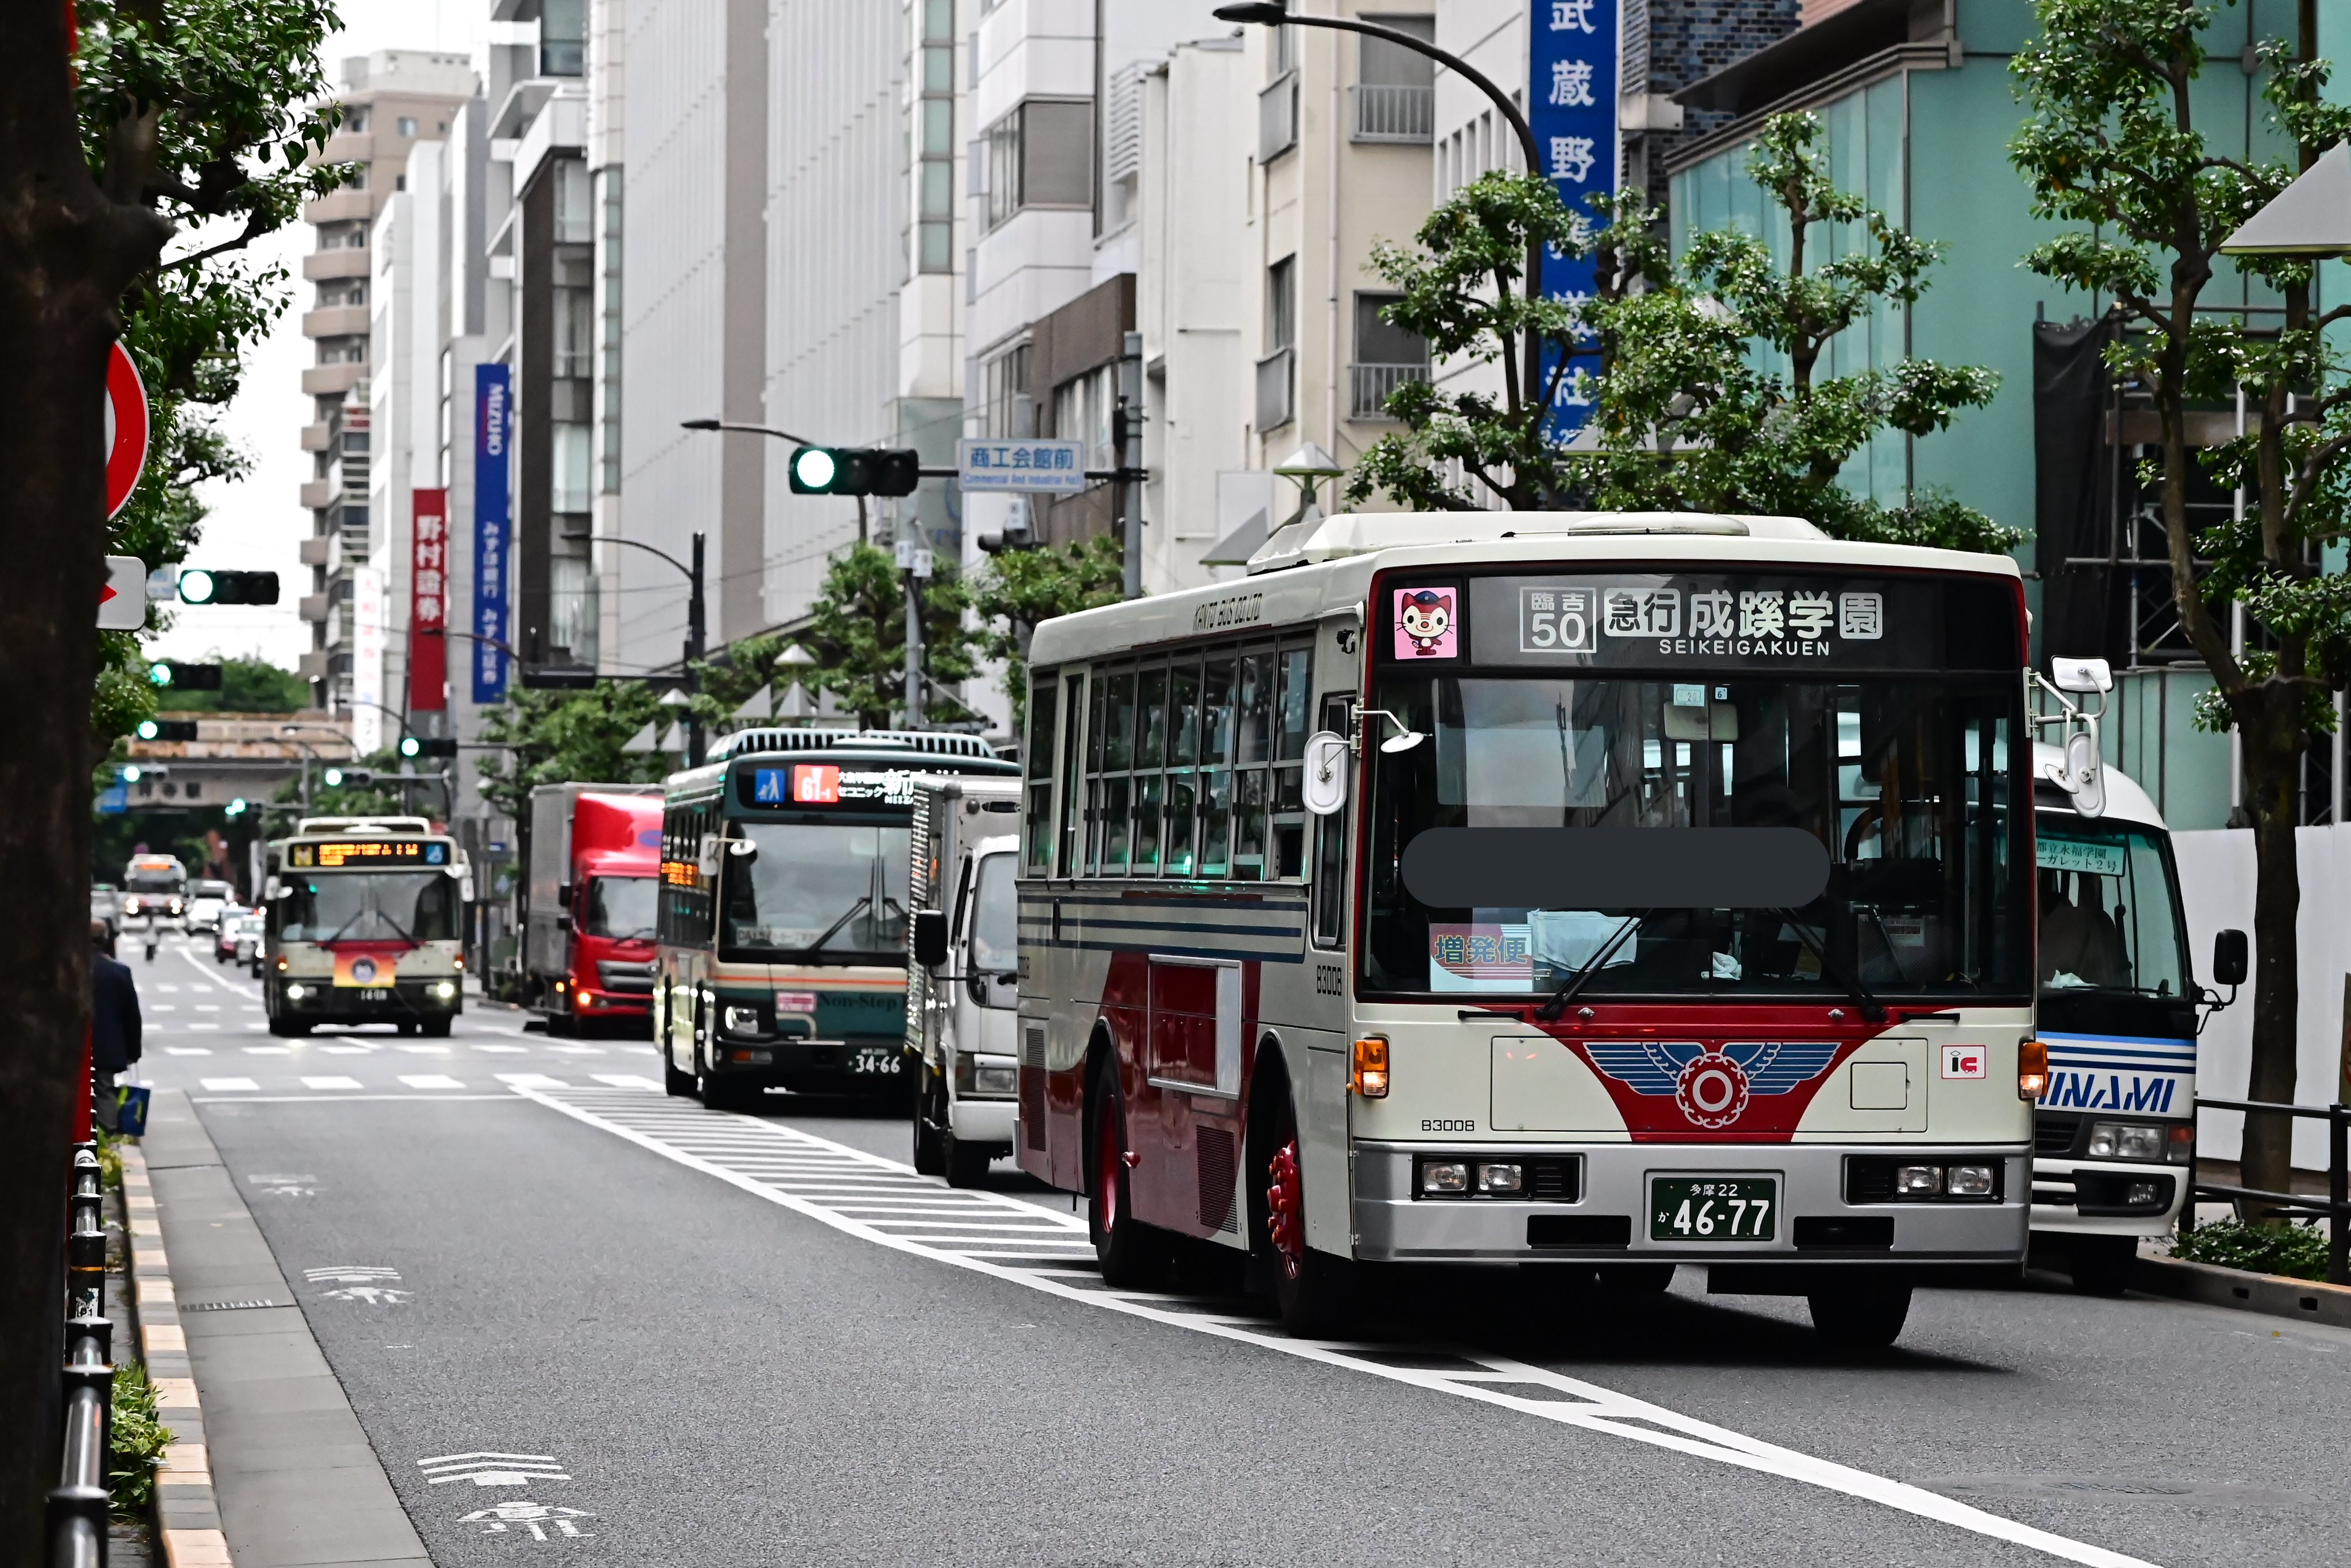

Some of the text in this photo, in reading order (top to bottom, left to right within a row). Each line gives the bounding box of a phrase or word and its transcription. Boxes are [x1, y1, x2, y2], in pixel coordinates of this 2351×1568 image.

[487, 383, 504, 456] MIZUHO
[971, 447, 1073, 469] 商工会館前
[1531, 592, 1586, 611] 臨吉
[1689, 589, 1883, 639] 成蹊学園
[1531, 612, 1586, 647] 50
[1659, 639, 1830, 657] SEIKEIGAKUEN
[1434, 934, 1528, 964] 増発便
[1317, 965, 1342, 996] B3008
[854, 1054, 901, 1074] 34-66
[1421, 1120, 1475, 1131] B3008
[1658, 1199, 1770, 1235] か 46-77
